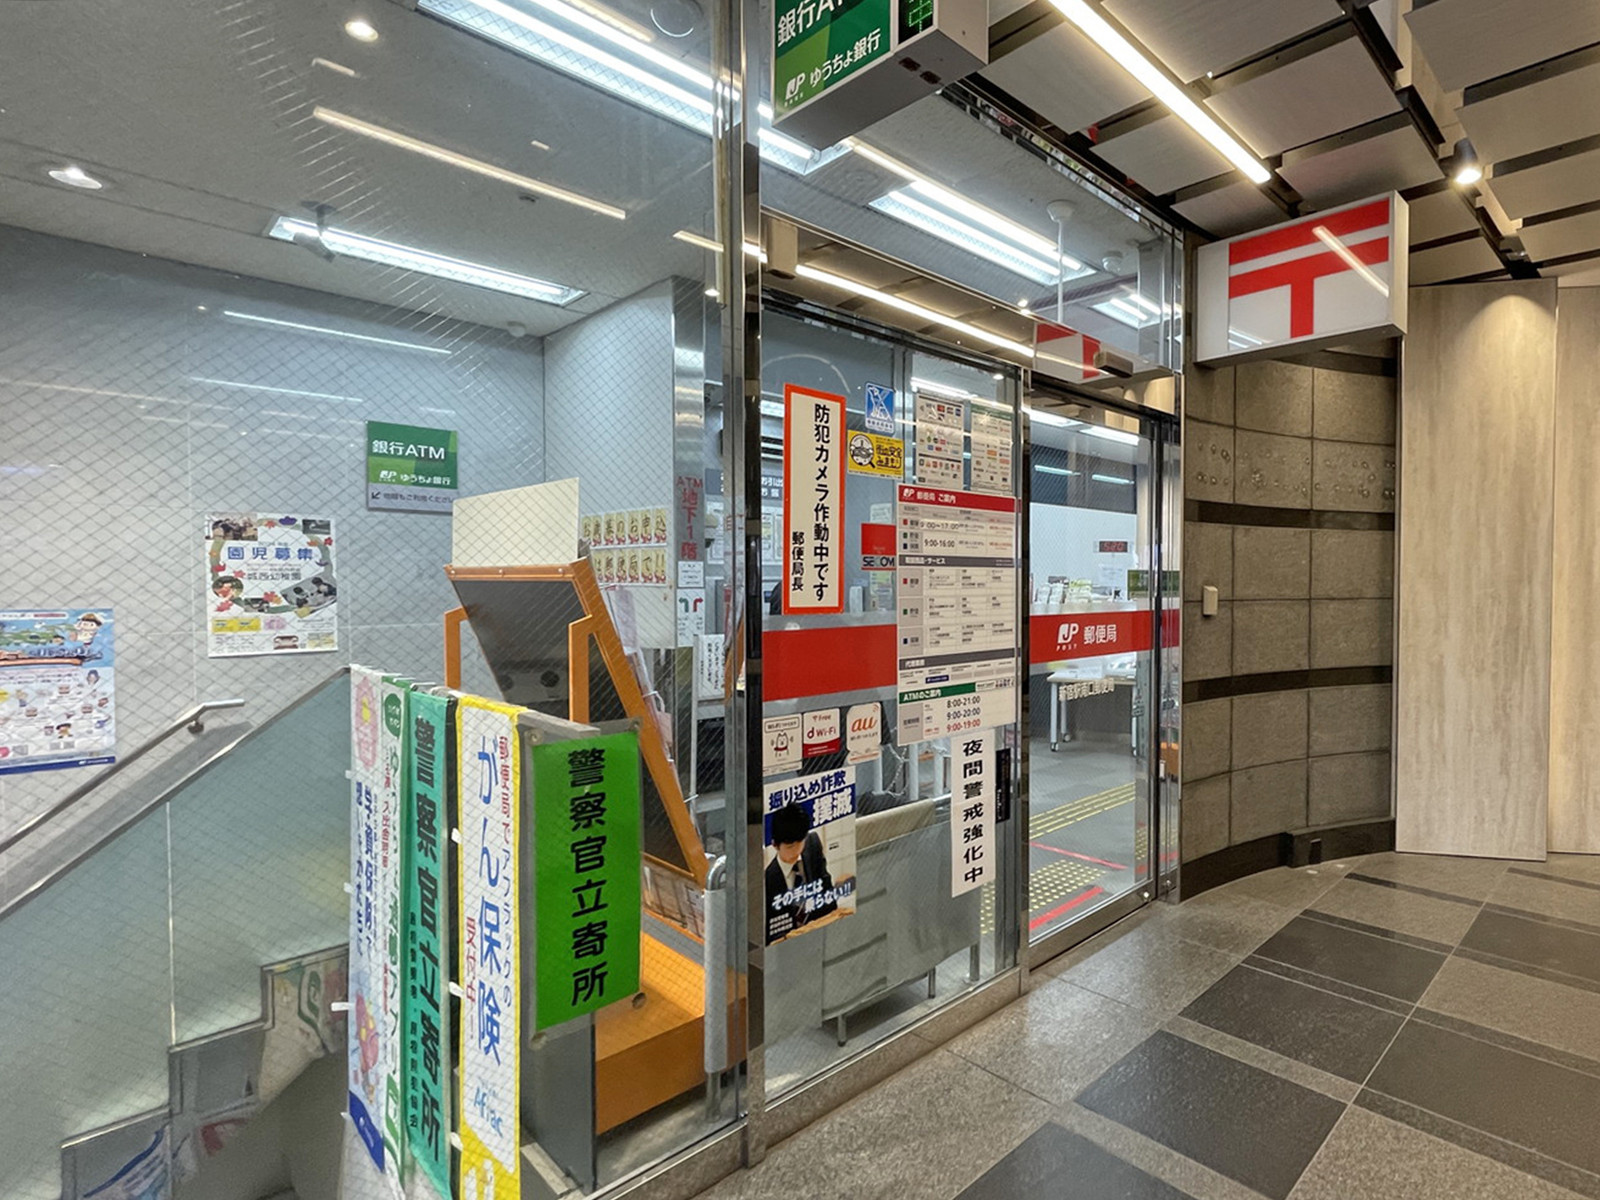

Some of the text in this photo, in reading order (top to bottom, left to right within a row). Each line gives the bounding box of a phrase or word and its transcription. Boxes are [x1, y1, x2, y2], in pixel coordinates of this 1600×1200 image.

[777, 0, 845, 47] 銀行A
[810, 28, 881, 88] ゆうちょ銀行
[372, 439, 446, 460] 銀行ATM
[400, 473, 451, 486] ゆうちょ銀行
[677, 476, 703, 488] ATM
[812, 403, 831, 602] 防犯カメラ作動中です
[938, 491, 957, 504] ご案内
[228, 546, 313, 561] 園児募集
[791, 531, 806, 592] 郵便局長
[862, 556, 895, 567] SEOM
[1083, 624, 1117, 645] 郵便局
[903, 688, 942, 702] ATMのご案内
[946, 695, 981, 709] 8:00-21:00
[851, 716, 878, 733] au
[946, 707, 981, 721] 9:00-20:00
[816, 726, 837, 737] Wi-Fi
[946, 718, 981, 733] 9:00-19:00
[769, 770, 846, 811] 振り込め詐欺
[813, 786, 853, 827] 撲滅
[962, 738, 985, 884] 夜間警戒強化中
[567, 747, 608, 1007] 警察官立寄所
[477, 735, 501, 1066] がん保険
[771, 878, 824, 911] その手には
[804, 882, 852, 914] 乗らない!!
[415, 714, 441, 1162] 警察官立寄所
